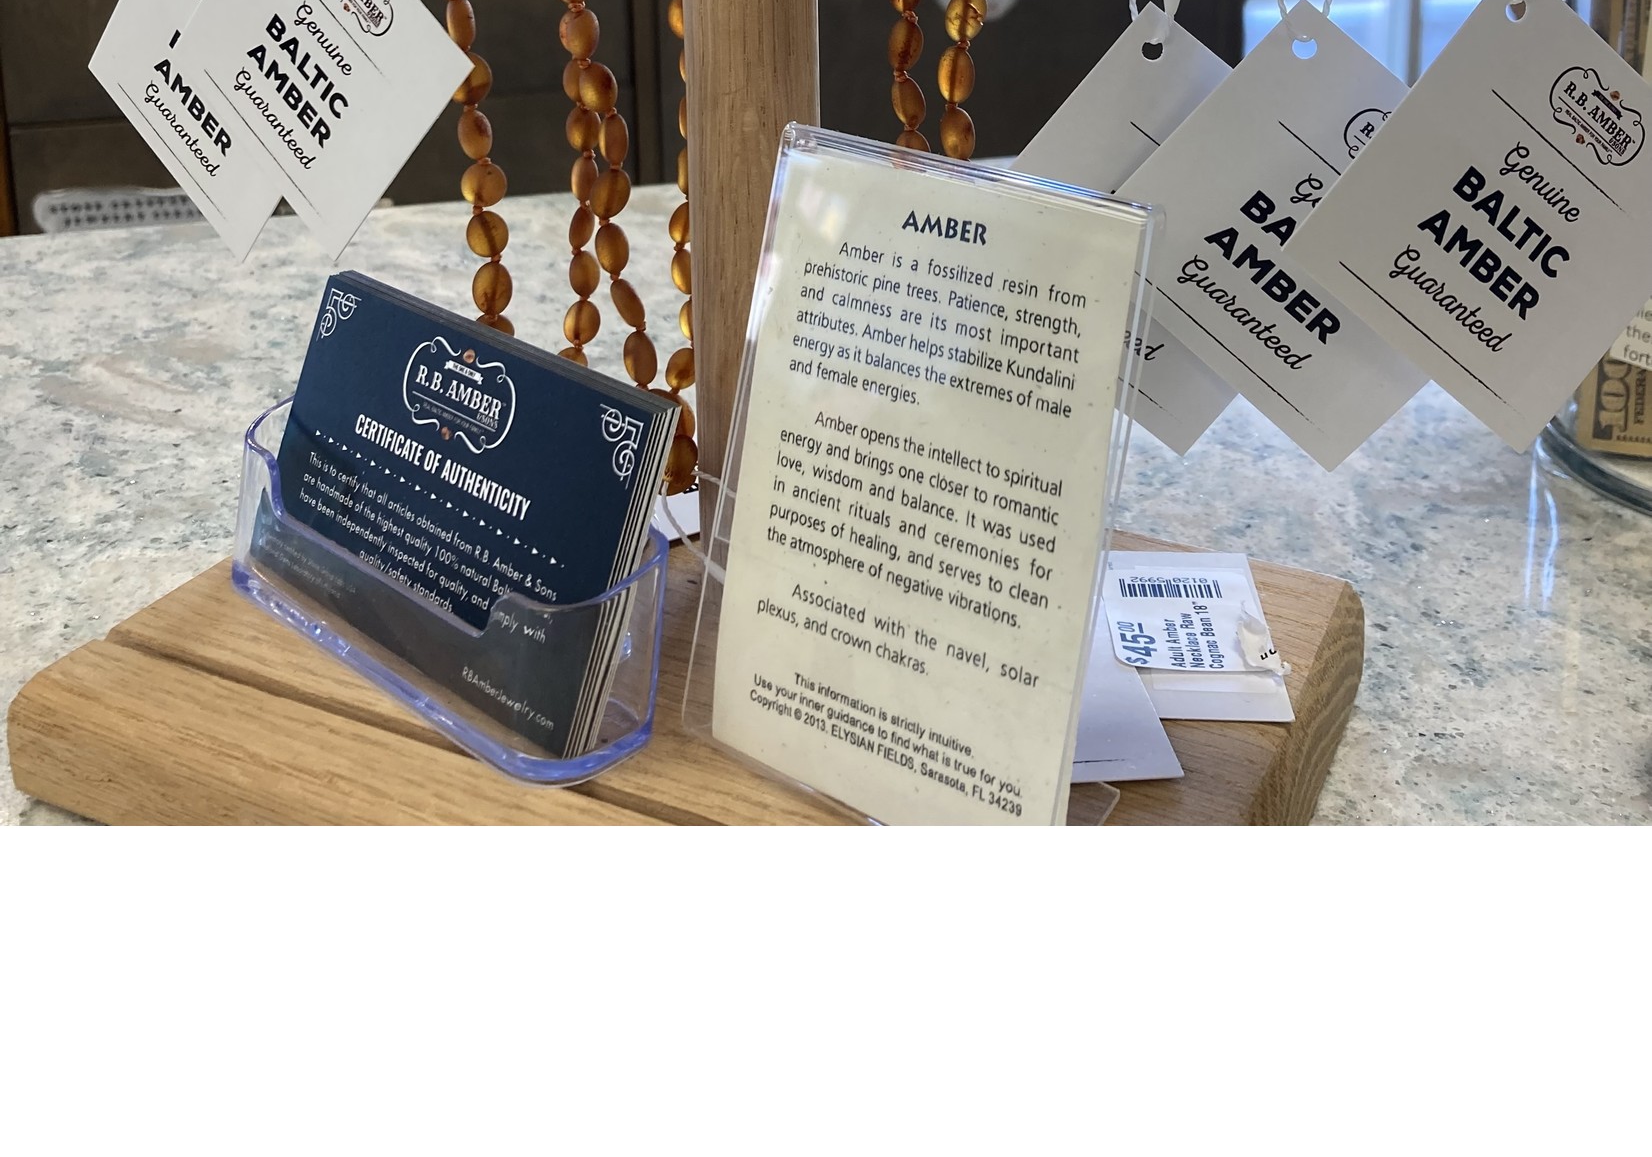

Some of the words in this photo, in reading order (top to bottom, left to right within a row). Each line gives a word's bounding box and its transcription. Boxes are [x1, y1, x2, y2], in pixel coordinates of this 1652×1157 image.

[265, 13, 349, 120] BALTIC
[294, 0, 352, 76] Genuine
[144, 80, 221, 177] Guaranteed
[153, 58, 232, 157] AMBER
[233, 66, 317, 170] Guaranteed
[246, 44, 331, 149] AMBER
[901, 210, 987, 246] AMBER
[1452, 165, 1570, 278] BALTIC
[1499, 141, 1580, 223] Genuine
[803, 262, 869, 287] prehistoric
[872, 274, 901, 294] pine
[906, 282, 941, 304] trees.
[948, 290, 1008, 322] Patience,
[1015, 308, 1081, 339] strength,
[838, 241, 885, 264] Amber
[892, 251, 903, 268] is
[910, 259, 919, 272] a
[927, 258, 994, 288] fossilized
[1002, 278, 1037, 298] resin
[1048, 284, 1087, 309] from
[1176, 254, 1313, 370] Guaranteed
[1203, 227, 1341, 345] AMBER
[1388, 243, 1513, 353] Guaranteed
[1416, 209, 1540, 321] AMBER
[796, 310, 858, 336] attributes.
[861, 323, 907, 348] Amber
[909, 333, 944, 360] helps
[947, 346, 1003, 373] stabilize
[1006, 358, 1076, 391] Kundalini
[800, 285, 825, 302] and
[831, 292, 892, 318] calmness
[900, 309, 922, 326] are
[929, 311, 947, 332] its
[955, 322, 992, 343] most
[1000, 328, 1080, 364] important
[415, 364, 444, 394] R.B.
[789, 359, 813, 376] and
[816, 361, 858, 388] female
[862, 378, 920, 406] energies.
[355, 413, 425, 466] CERTIFICATE
[423, 449, 442, 474] OF
[440, 458, 531, 521] AUTHENTICITY
[776, 449, 805, 476] love,
[812, 464, 863, 492] wisdom
[868, 483, 896, 502] and
[901, 488, 958, 523] balance.
[965, 509, 976, 529] It
[982, 519, 1012, 540] was
[1019, 529, 1057, 554] used
[780, 429, 823, 456] energy
[825, 443, 851, 462] and
[854, 447, 894, 477] brings
[898, 465, 924, 485] one
[929, 472, 969, 498] closer
[974, 486, 988, 504] to
[993, 494, 1059, 527] romantic
[814, 411, 859, 436] Amber
[860, 427, 900, 449] opens
[903, 436, 925, 457] the
[928, 442, 982, 475] intellect
[986, 460, 1001, 479] to
[1004, 468, 1063, 498] spiritual
[299, 487, 316, 507] have
[317, 498, 335, 519] been
[335, 509, 388, 553] independently
[387, 541, 426, 572] inspected
[425, 562, 439, 580] for
[439, 575, 469, 602] quality,
[471, 594, 490, 611] and
[522, 624, 545, 643] with
[303, 473, 316, 486] are
[316, 476, 354, 508] handmade
[354, 500, 365, 514] of
[363, 505, 376, 521] the
[376, 511, 405, 538] highest
[404, 532, 433, 557] quality
[434, 545, 459, 570] 100%
[460, 564, 493, 588] natural
[309, 451, 322, 468] This
[322, 457, 328, 472] is
[329, 464, 337, 477] to
[337, 472, 361, 493] certify
[360, 482, 377, 499] that
[376, 492, 389, 506] all
[387, 500, 415, 522] articles
[416, 514, 454, 543] obtained
[453, 532, 473, 555] from
[474, 543, 489, 565] R.B.
[492, 556, 524, 582] Amber
[524, 573, 532, 588] &
[534, 578, 557, 601] Sons
[773, 474, 786, 494] in
[792, 485, 842, 513] ancient
[848, 500, 891, 529] rituals
[898, 520, 927, 540] and
[934, 531, 1020, 571] ceremonies
[1030, 557, 1053, 581] for
[767, 525, 787, 546] the
[789, 536, 865, 573] atmosphere
[868, 562, 883, 580] of
[886, 570, 944, 602] negative
[948, 590, 1021, 629] vibrations.
[1180, 613, 1195, 630] Raw
[1192, 601, 1209, 615] 18"
[756, 597, 799, 628] plexus,
[803, 616, 828, 636] and
[830, 627, 872, 654] crown
[875, 642, 929, 676] chakras.
[791, 583, 866, 624] Associated
[873, 615, 905, 639] with
[915, 628, 938, 651] the
[946, 643, 990, 673] navel,
[1000, 663, 1040, 688] solar
[1163, 619, 1181, 644] Amber
[1168, 646, 1186, 668] Adult
[1186, 633, 1205, 668] Necklace
[1200, 617, 1216, 637] Bean
[1207, 640, 1225, 669] Cognac
[749, 689, 792, 717] Copyright
[831, 723, 875, 753] ELYSIAN
[876, 743, 917, 774] FIELDS,
[920, 762, 968, 797] Sarasota,
[971, 784, 986, 802] FL
[988, 791, 1022, 818] 34239
[753, 673, 773, 691] Use
[775, 685, 798, 701] your
[799, 692, 825, 713] inner
[826, 707, 875, 735] guidance
[877, 726, 888, 740] to
[890, 731, 911, 750] find
[912, 743, 939, 763] what
[941, 752, 951, 768] is
[954, 758, 977, 778] true
[980, 768, 996, 786] for
[794, 671, 816, 692] This
[817, 682, 876, 717] information
[878, 707, 888, 722] is
[890, 715, 926, 740] strictly
[928, 728, 974, 759] intuitive.
